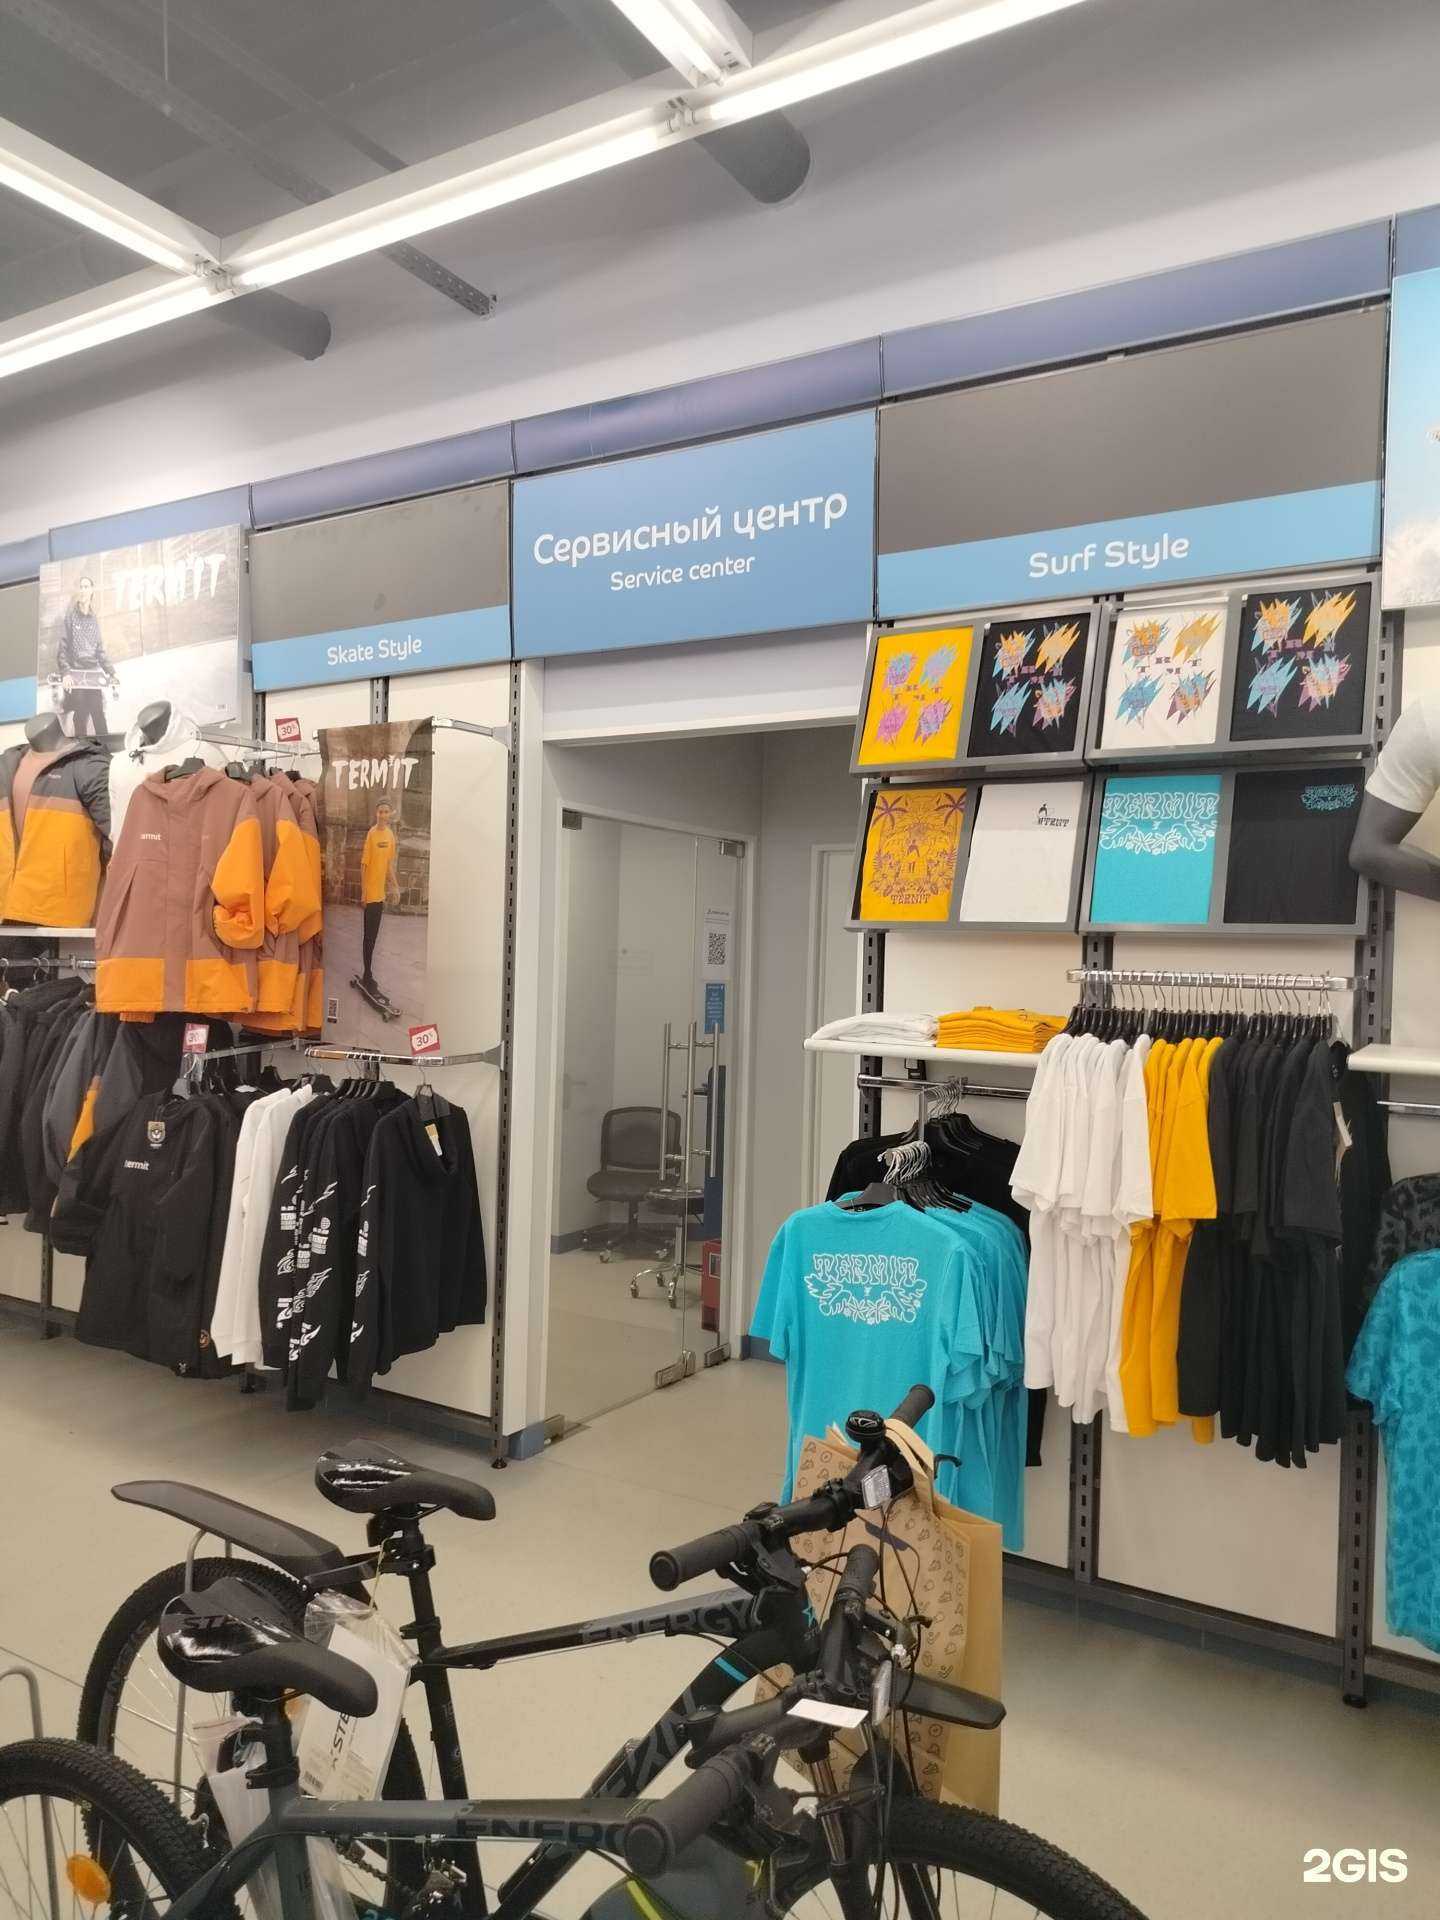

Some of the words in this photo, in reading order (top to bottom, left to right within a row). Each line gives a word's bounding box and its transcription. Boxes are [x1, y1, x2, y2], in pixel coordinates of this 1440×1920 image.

[533, 504, 722, 568] Сервисный
[733, 492, 849, 541] центр
[610, 565, 684, 592] Service
[689, 555, 756, 581] center
[1028, 543, 1097, 578] Surf
[1104, 532, 1190, 570] Style
[327, 644, 374, 666] Skate
[378, 634, 422, 661] Style
[331, 754, 419, 790] TERMIT
[812, 1252, 919, 1288] TERMIT
[580, 1599, 752, 1645] ENERGY
